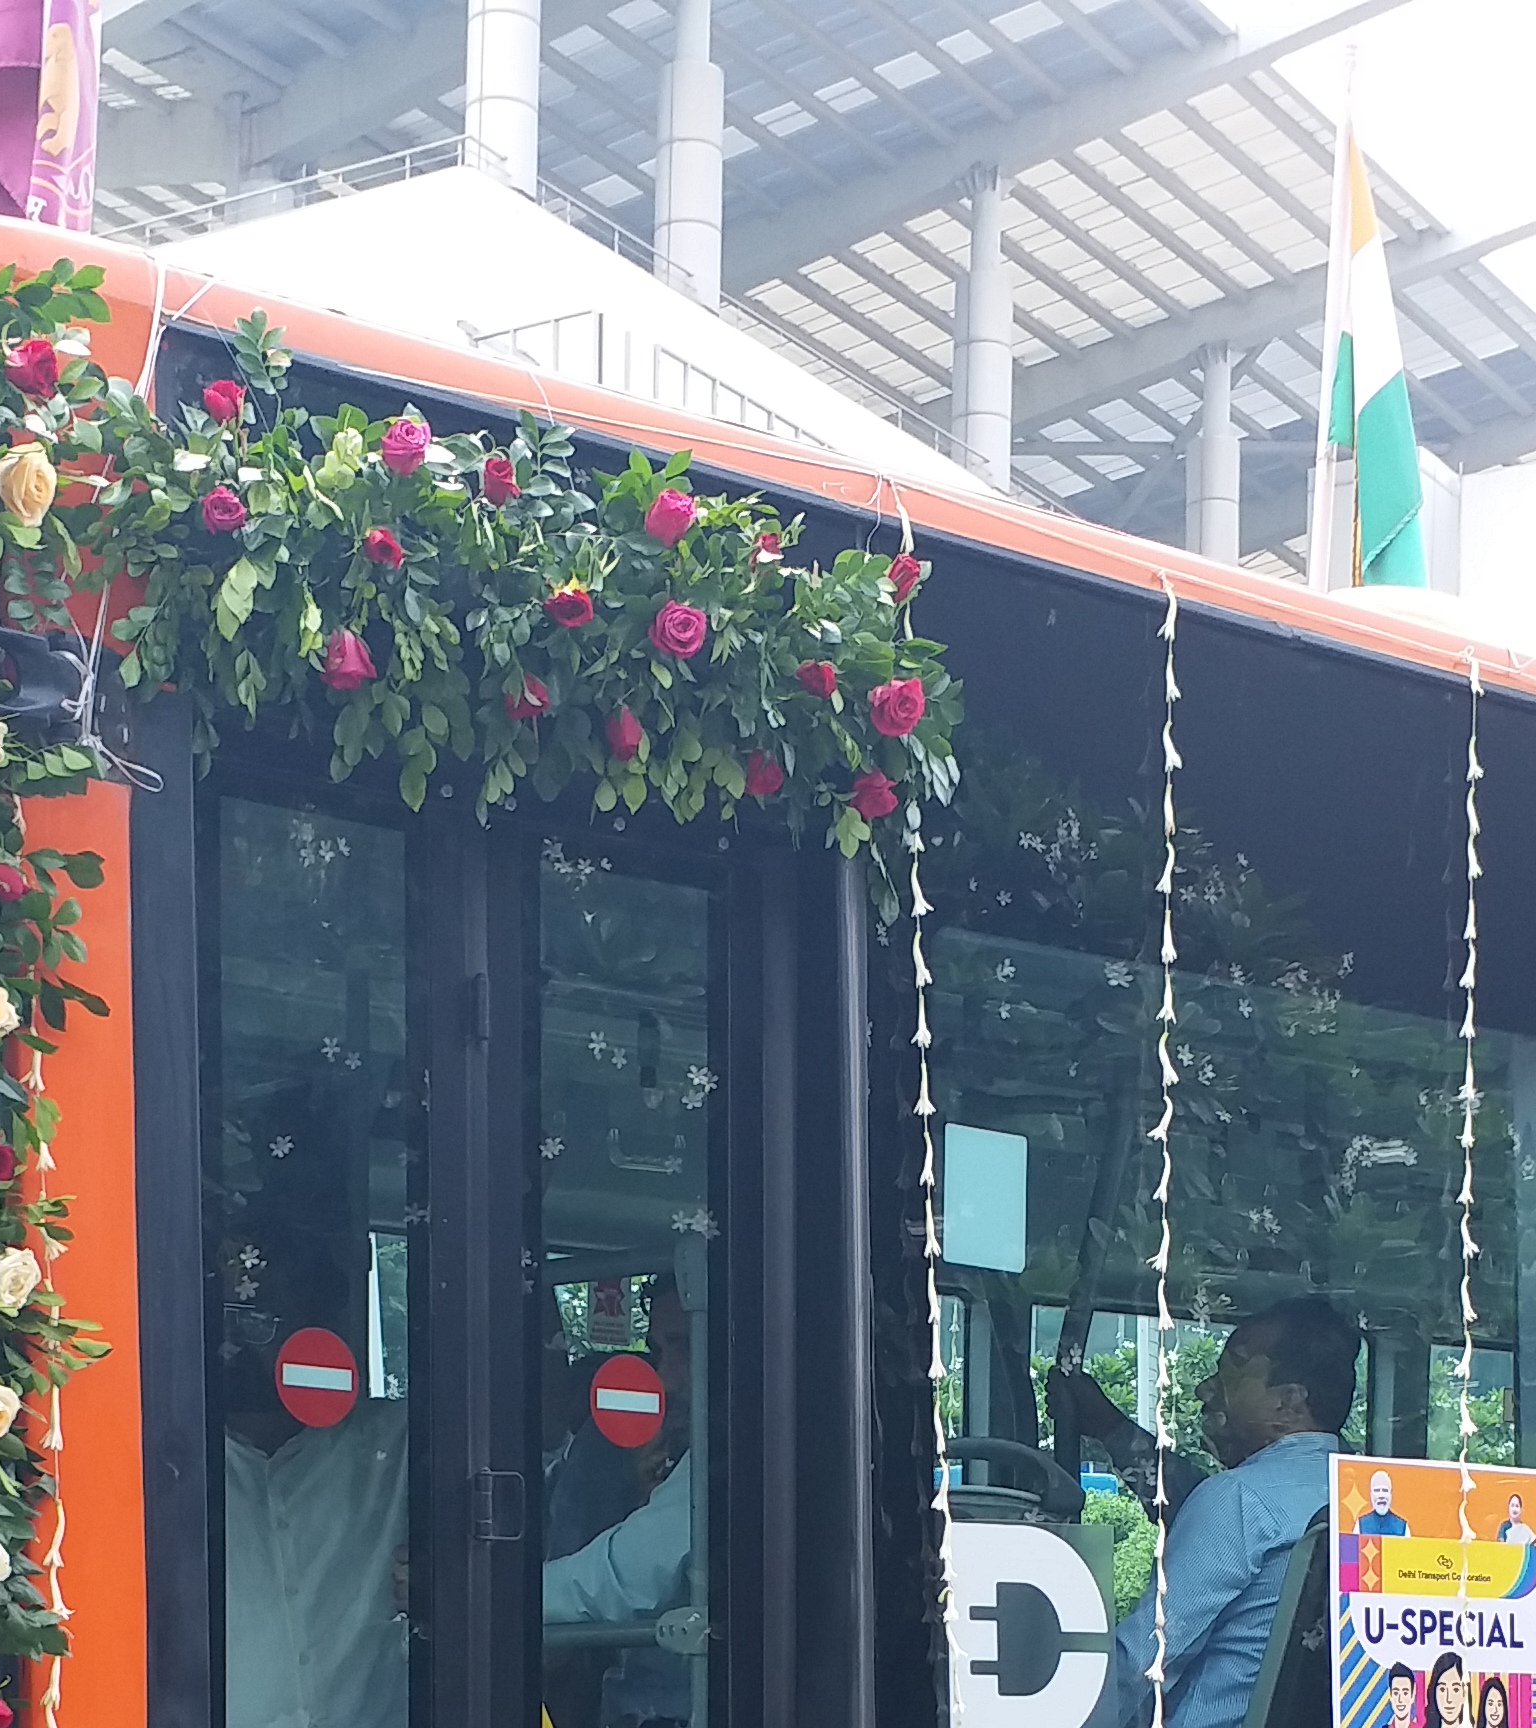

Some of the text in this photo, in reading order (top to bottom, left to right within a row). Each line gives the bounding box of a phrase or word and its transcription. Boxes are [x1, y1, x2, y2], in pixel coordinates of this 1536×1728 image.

[1418, 1570, 1450, 1582] Transport
[1451, 1572, 1491, 1582] Cooration
[1364, 1607, 1524, 1649] U-SPECIAL
